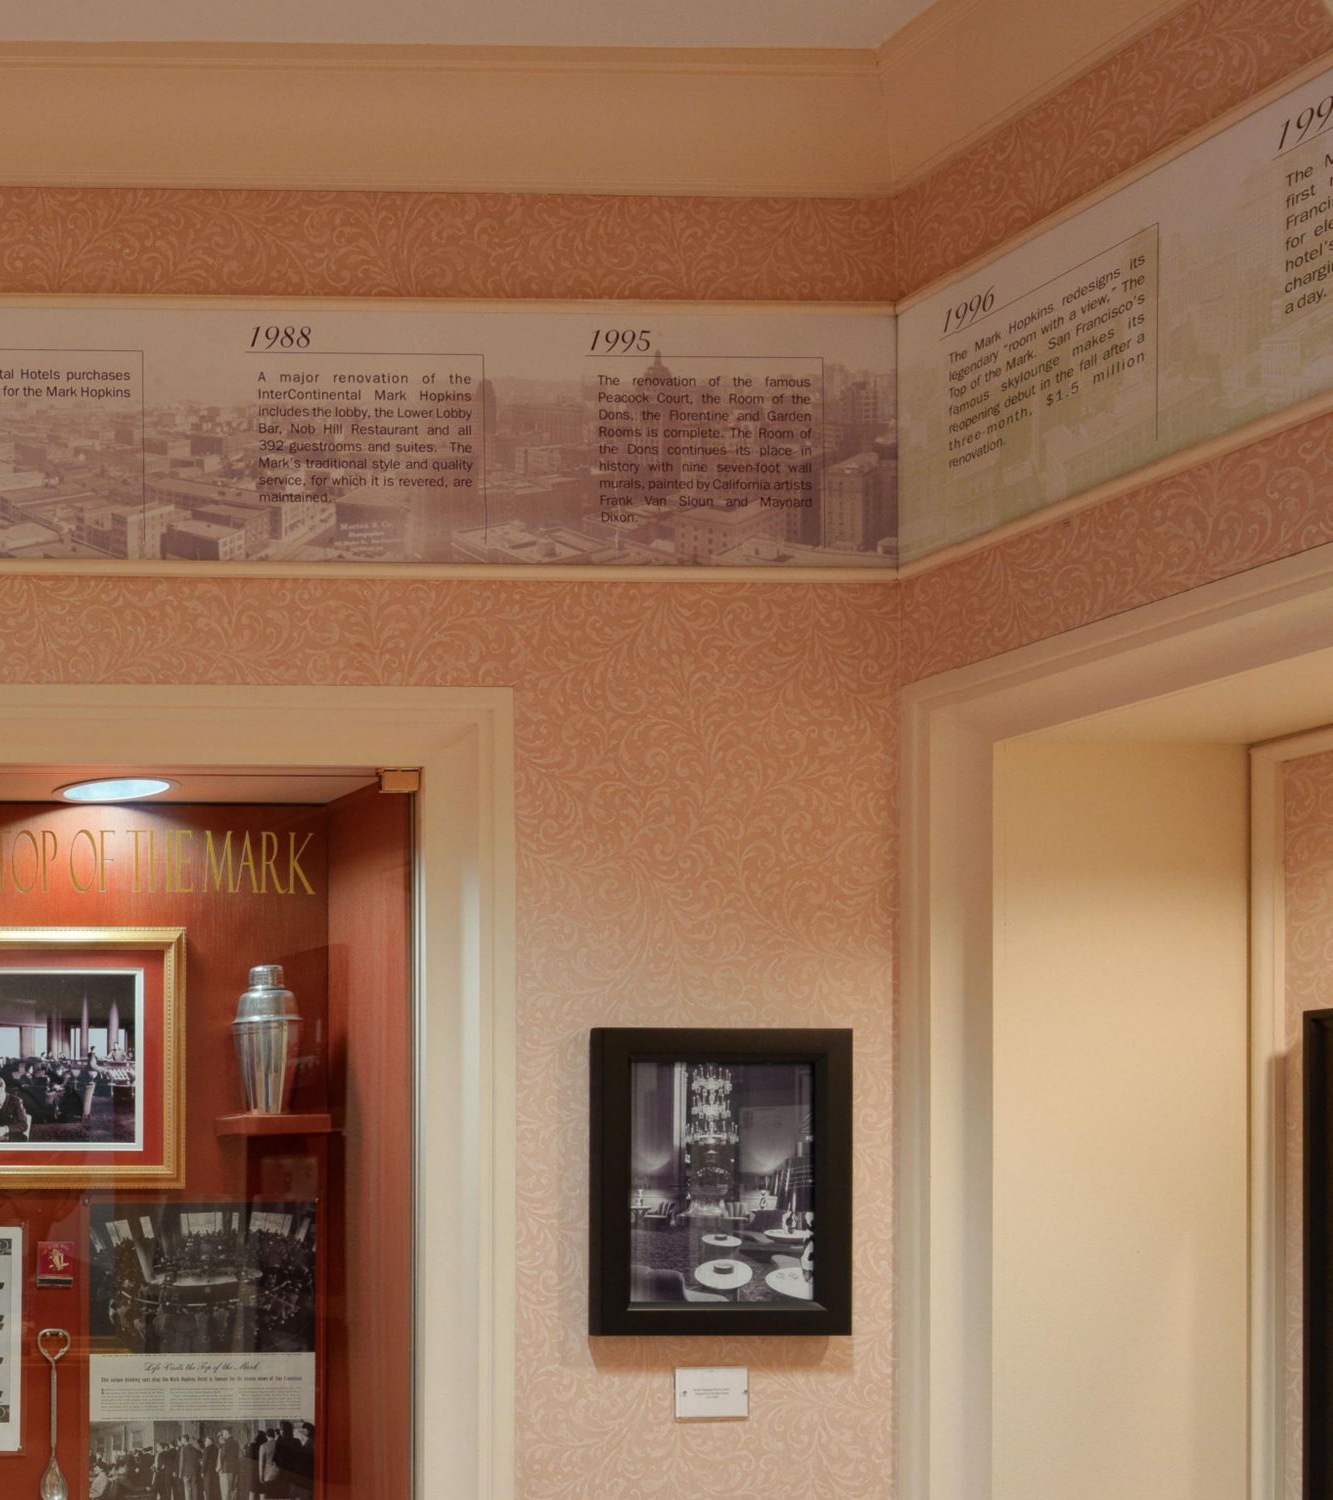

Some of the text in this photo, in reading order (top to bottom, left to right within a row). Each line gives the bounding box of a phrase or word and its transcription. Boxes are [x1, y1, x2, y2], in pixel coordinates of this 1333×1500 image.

[943, 285, 995, 334] 1996
[250, 325, 312, 349] 1988
[590, 329, 651, 353] 1995
[20, 369, 60, 380] Hotels
[66, 370, 130, 381] purchases
[3, 386, 19, 396] for
[23, 387, 42, 397] the
[46, 387, 77, 397] Mark
[81, 387, 130, 399] Hopkins
[69, 829, 116, 893] OF
[127, 830, 193, 893] THE
[204, 830, 316, 895] MARK
